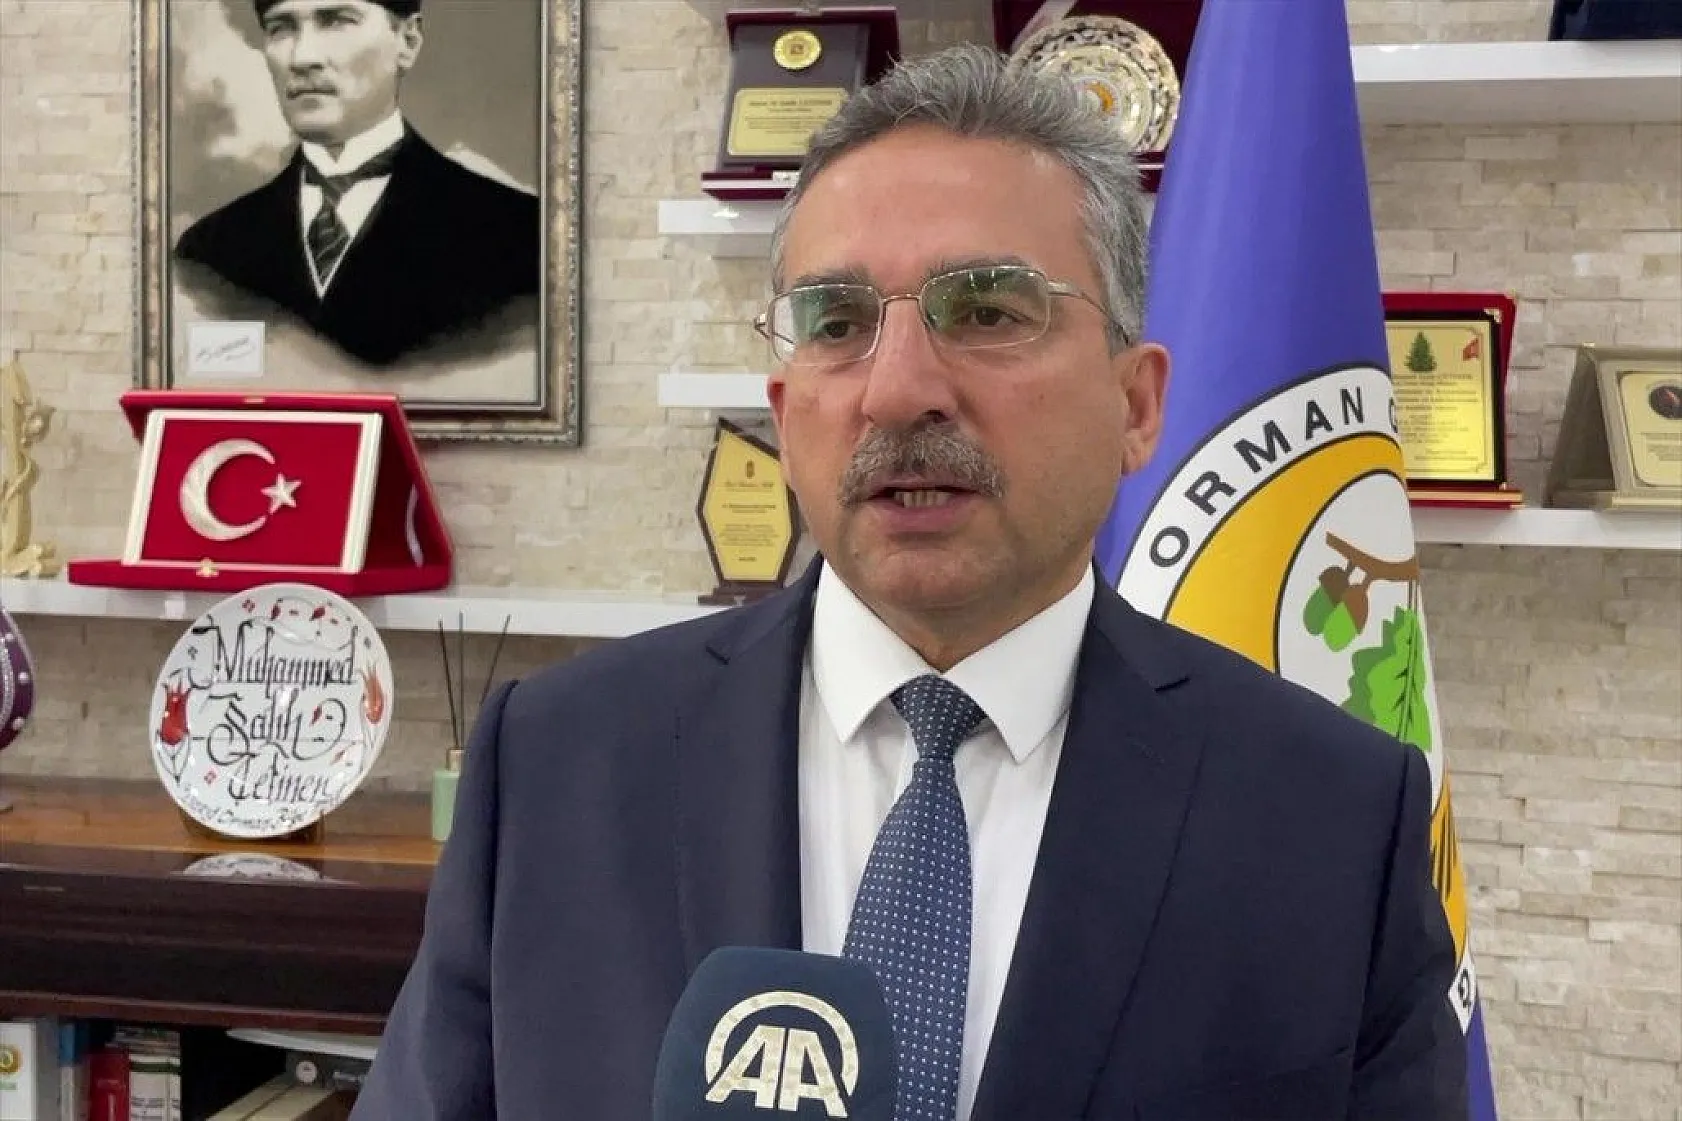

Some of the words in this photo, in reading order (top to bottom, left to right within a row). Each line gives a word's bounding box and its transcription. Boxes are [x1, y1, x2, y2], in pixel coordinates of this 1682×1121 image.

[1150, 386, 1365, 568] ORMAN
[192, 617, 359, 698] Muhammed
[706, 1024, 848, 1118] AA
